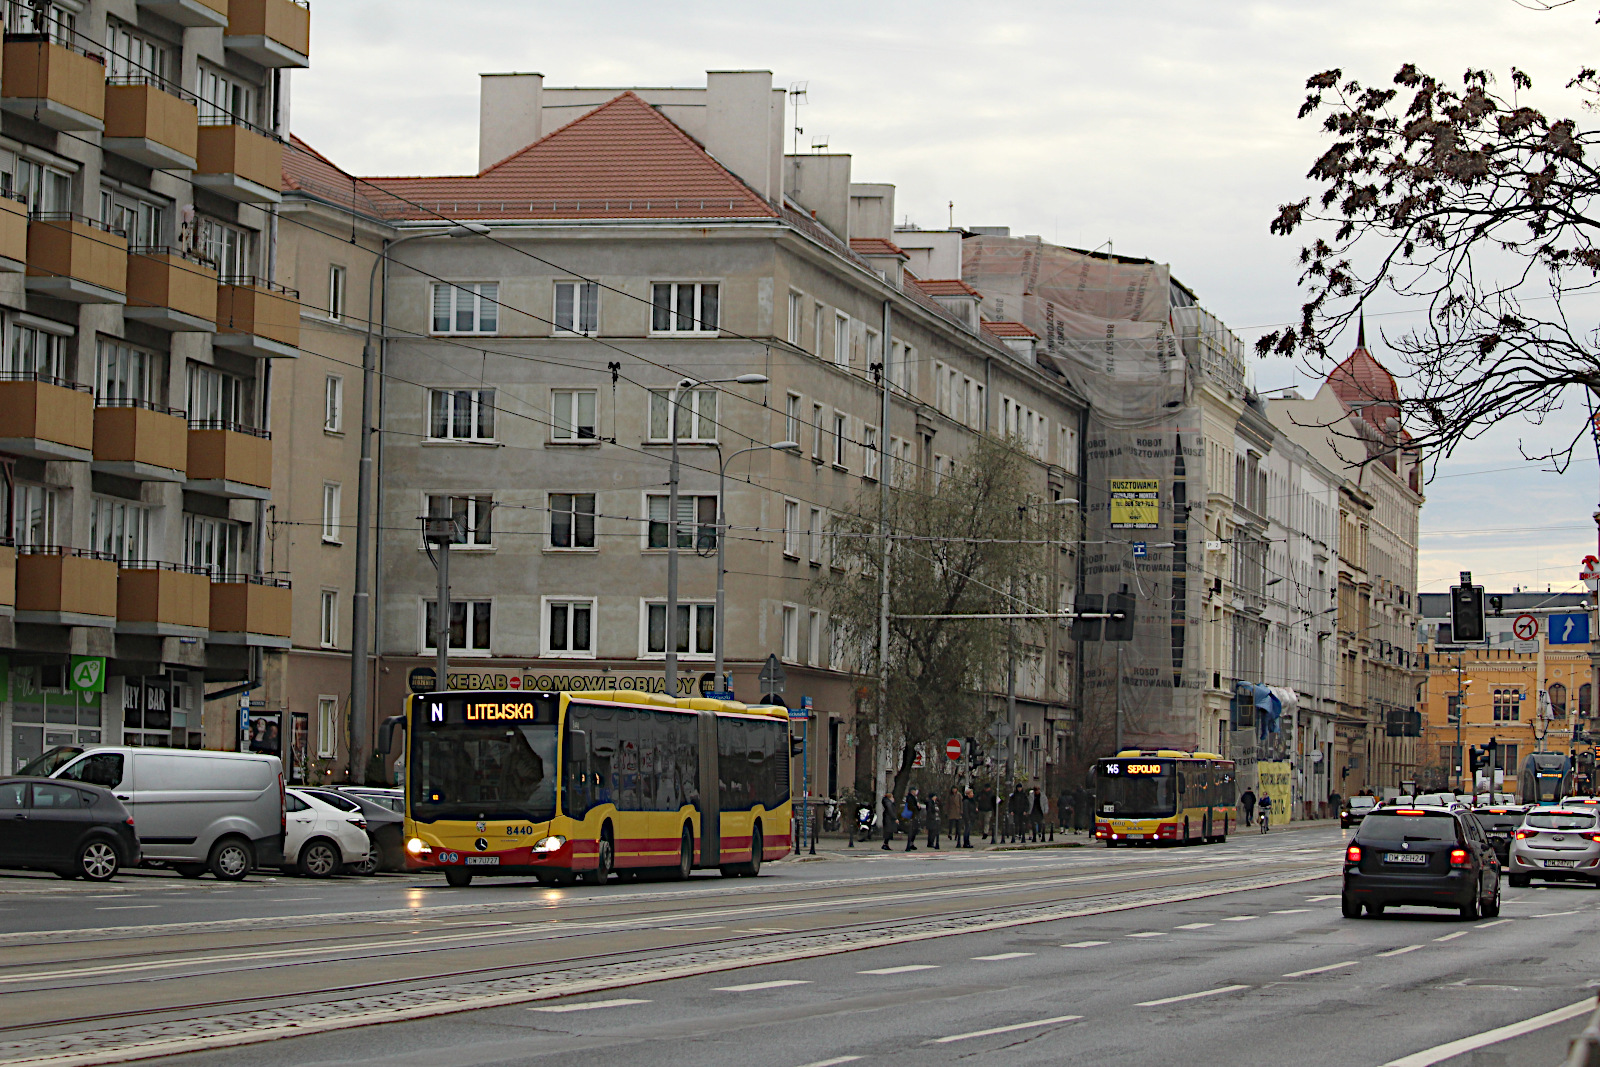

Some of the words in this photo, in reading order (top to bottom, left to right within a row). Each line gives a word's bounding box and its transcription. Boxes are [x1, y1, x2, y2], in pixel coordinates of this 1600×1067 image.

[1106, 324, 1115, 338] 886
[1137, 439, 1162, 447] ROBOT
[1112, 481, 1158, 489] RUSZTOWANIA
[446, 673, 508, 690] KEBAB
[523, 675, 617, 692] DOMOWE
[619, 677, 695, 694] OBIADY
[148, 687, 166, 711] BAR
[431, 703, 443, 721] N
[467, 703, 534, 719] LITEWSKA
[1106, 764, 1119, 774] 145
[506, 826, 533, 835] 8440
